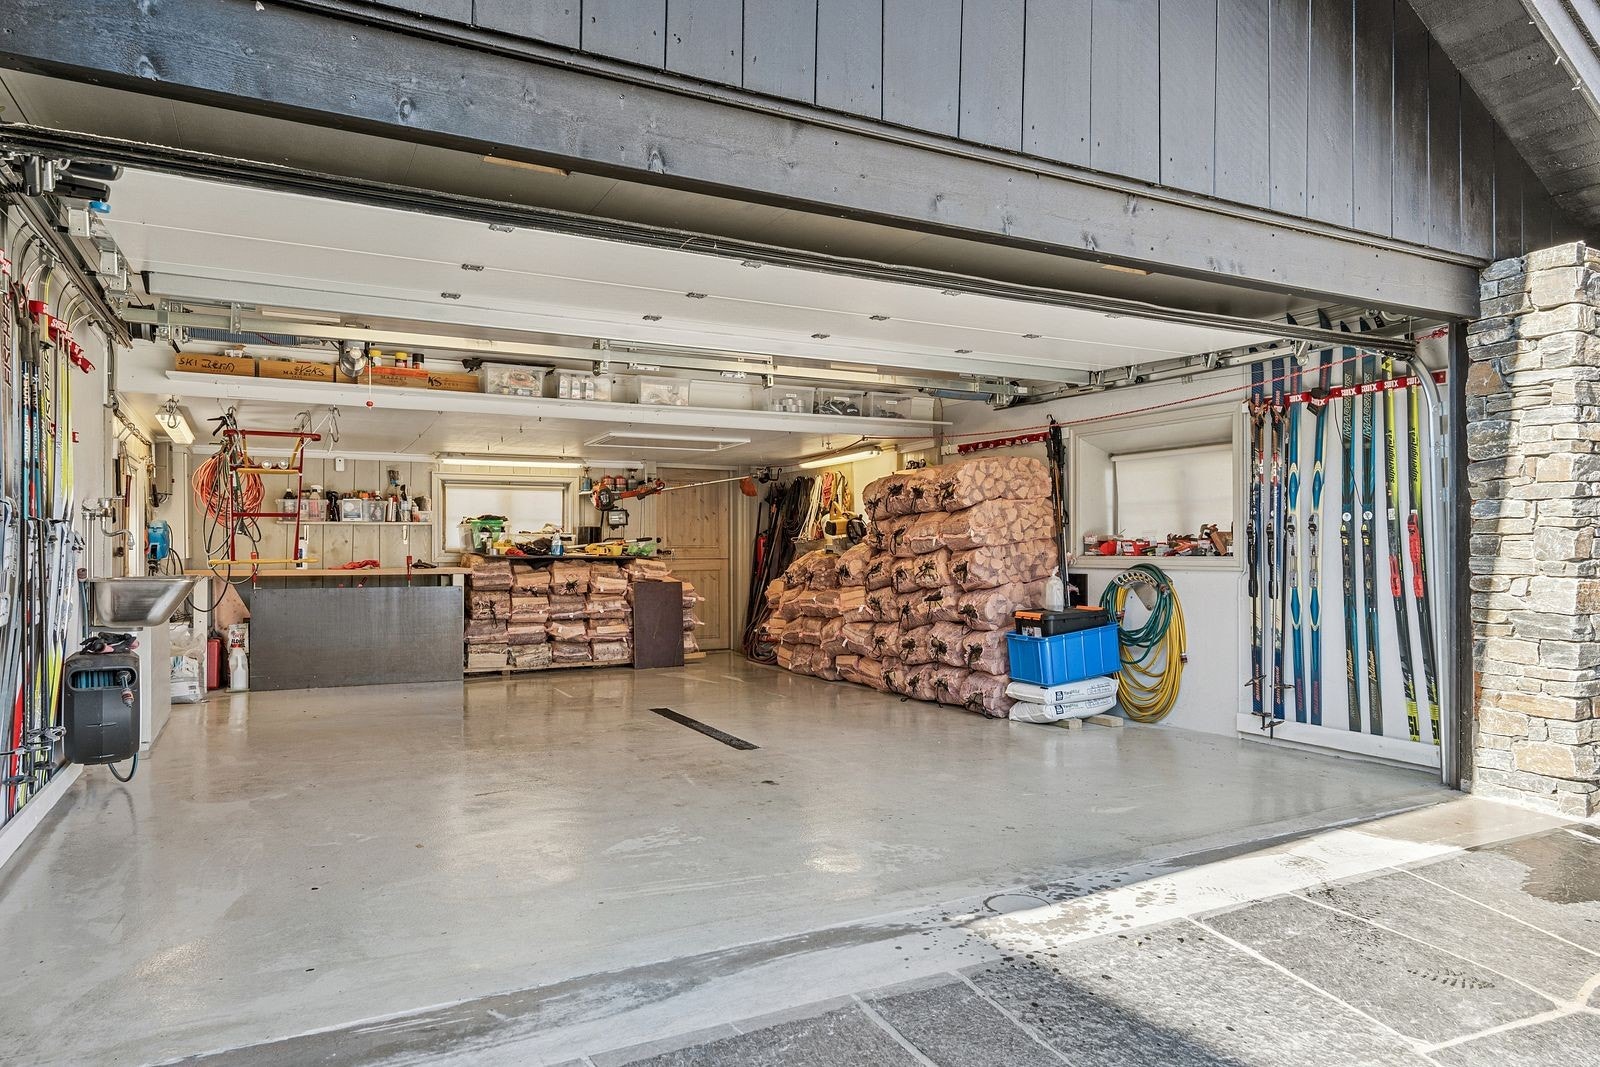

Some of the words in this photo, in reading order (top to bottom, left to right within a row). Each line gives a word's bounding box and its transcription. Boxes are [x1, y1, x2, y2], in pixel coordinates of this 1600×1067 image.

[178, 357, 198, 367] SKI
[1361, 383, 1378, 392] SWIX
[1384, 380, 1399, 388] SWIX
[1341, 387, 1357, 396] SWIX
